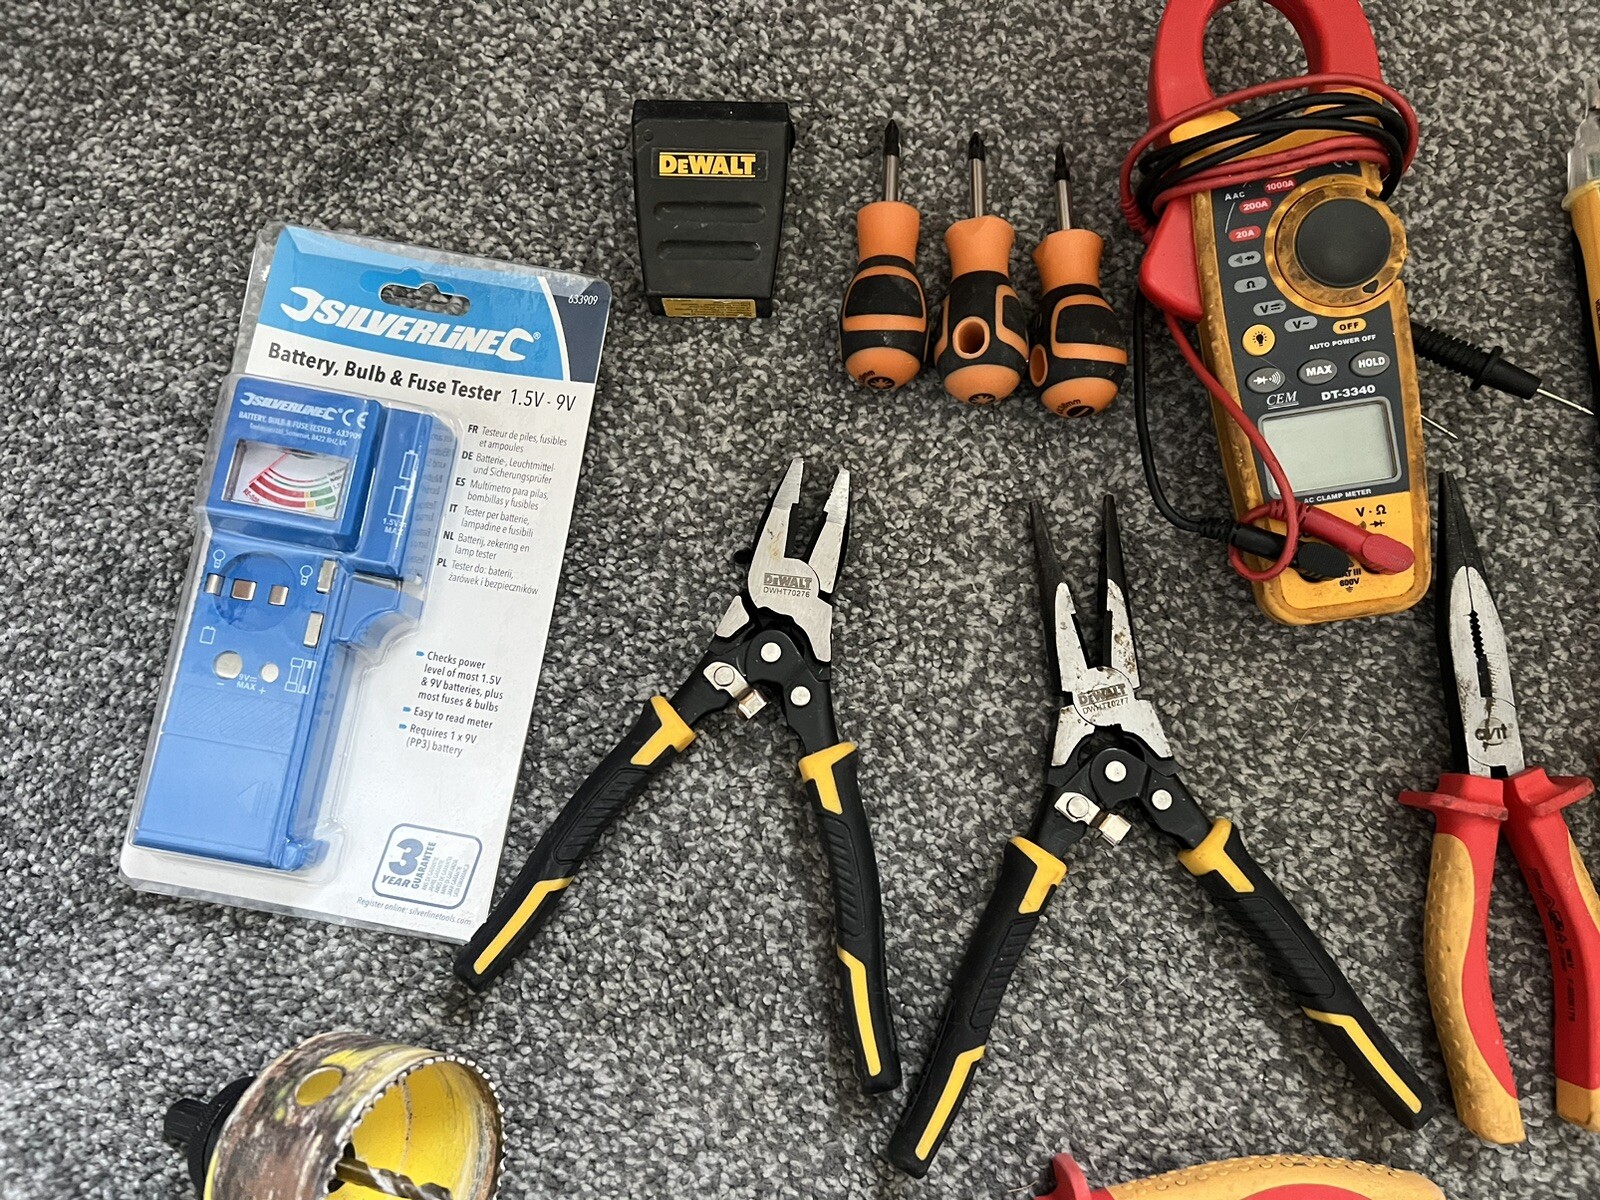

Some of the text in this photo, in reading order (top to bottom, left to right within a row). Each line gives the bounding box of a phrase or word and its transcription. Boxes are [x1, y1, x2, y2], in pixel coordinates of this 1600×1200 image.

[659, 153, 756, 176] DEWALT
[1266, 179, 1295, 191] 1000A
[1242, 200, 1269, 211] 200A
[1235, 229, 1255, 239] 20A
[568, 294, 599, 305] 633909
[1339, 322, 1359, 331] OFF
[1309, 334, 1377, 351] AUTO POWER OFF
[1306, 365, 1332, 377] MAX
[1358, 356, 1385, 369] HOLD
[268, 342, 338, 376] Battery,
[344, 361, 386, 383] Bulb
[390, 369, 404, 386] &
[407, 373, 447, 394] Fuse
[451, 380, 502, 402] Tester
[510, 388, 545, 408] 1.5V
[556, 394, 577, 411] 9V
[1266, 391, 1298, 407] CEM
[1321, 384, 1376, 401] DT-3340
[468, 424, 568, 447] FR Testeur de piles, fusibles
[479, 440, 524, 453] et ampoules
[461, 451, 473, 461] DE
[473, 465, 552, 485] und Sicherungsprüfer
[455, 477, 466, 487] ES
[512, 487, 529, 497] para
[530, 489, 549, 501] pilas,
[1316, 493, 1343, 502] CLAMP
[1345, 489, 1372, 498] METER
[467, 492, 503, 506] bombillas
[510, 498, 539, 511] fusibles
[449, 504, 530, 525] IT Tester per batterie,
[1356, 507, 1365, 517] V
[461, 518, 501, 534] lampadine
[508, 525, 534, 538] fusibili
[443, 531, 530, 553] NL Batterij, zekering en
[455, 545, 497, 560] lamp tester
[437, 558, 514, 580] PL Tester do: baterii,
[484, 578, 539, 595] bezpieczników
[764, 573, 812, 590] DEWALT
[1339, 577, 1360, 587] 600V
[763, 587, 810, 598] DWHT70276
[427, 651, 486, 669] Checks power
[424, 664, 502, 685] level of most 1.5V
[236, 681, 257, 691] MAX
[420, 677, 504, 700] & 9V batteries, plus
[418, 691, 499, 713] most fuses & bulbs
[413, 706, 494, 729] Easy to read meter
[409, 723, 448, 740] Requires
[457, 734, 463, 742] x
[464, 733, 478, 744] 9V
[406, 736, 464, 758] (PP3) battery
[388, 838, 424, 876] 3
[411, 841, 437, 890] GUARANTEE
[381, 874, 411, 888] YEAR
[356, 896, 384, 909] Register
[409, 907, 472, 926] silverlinetools.com
